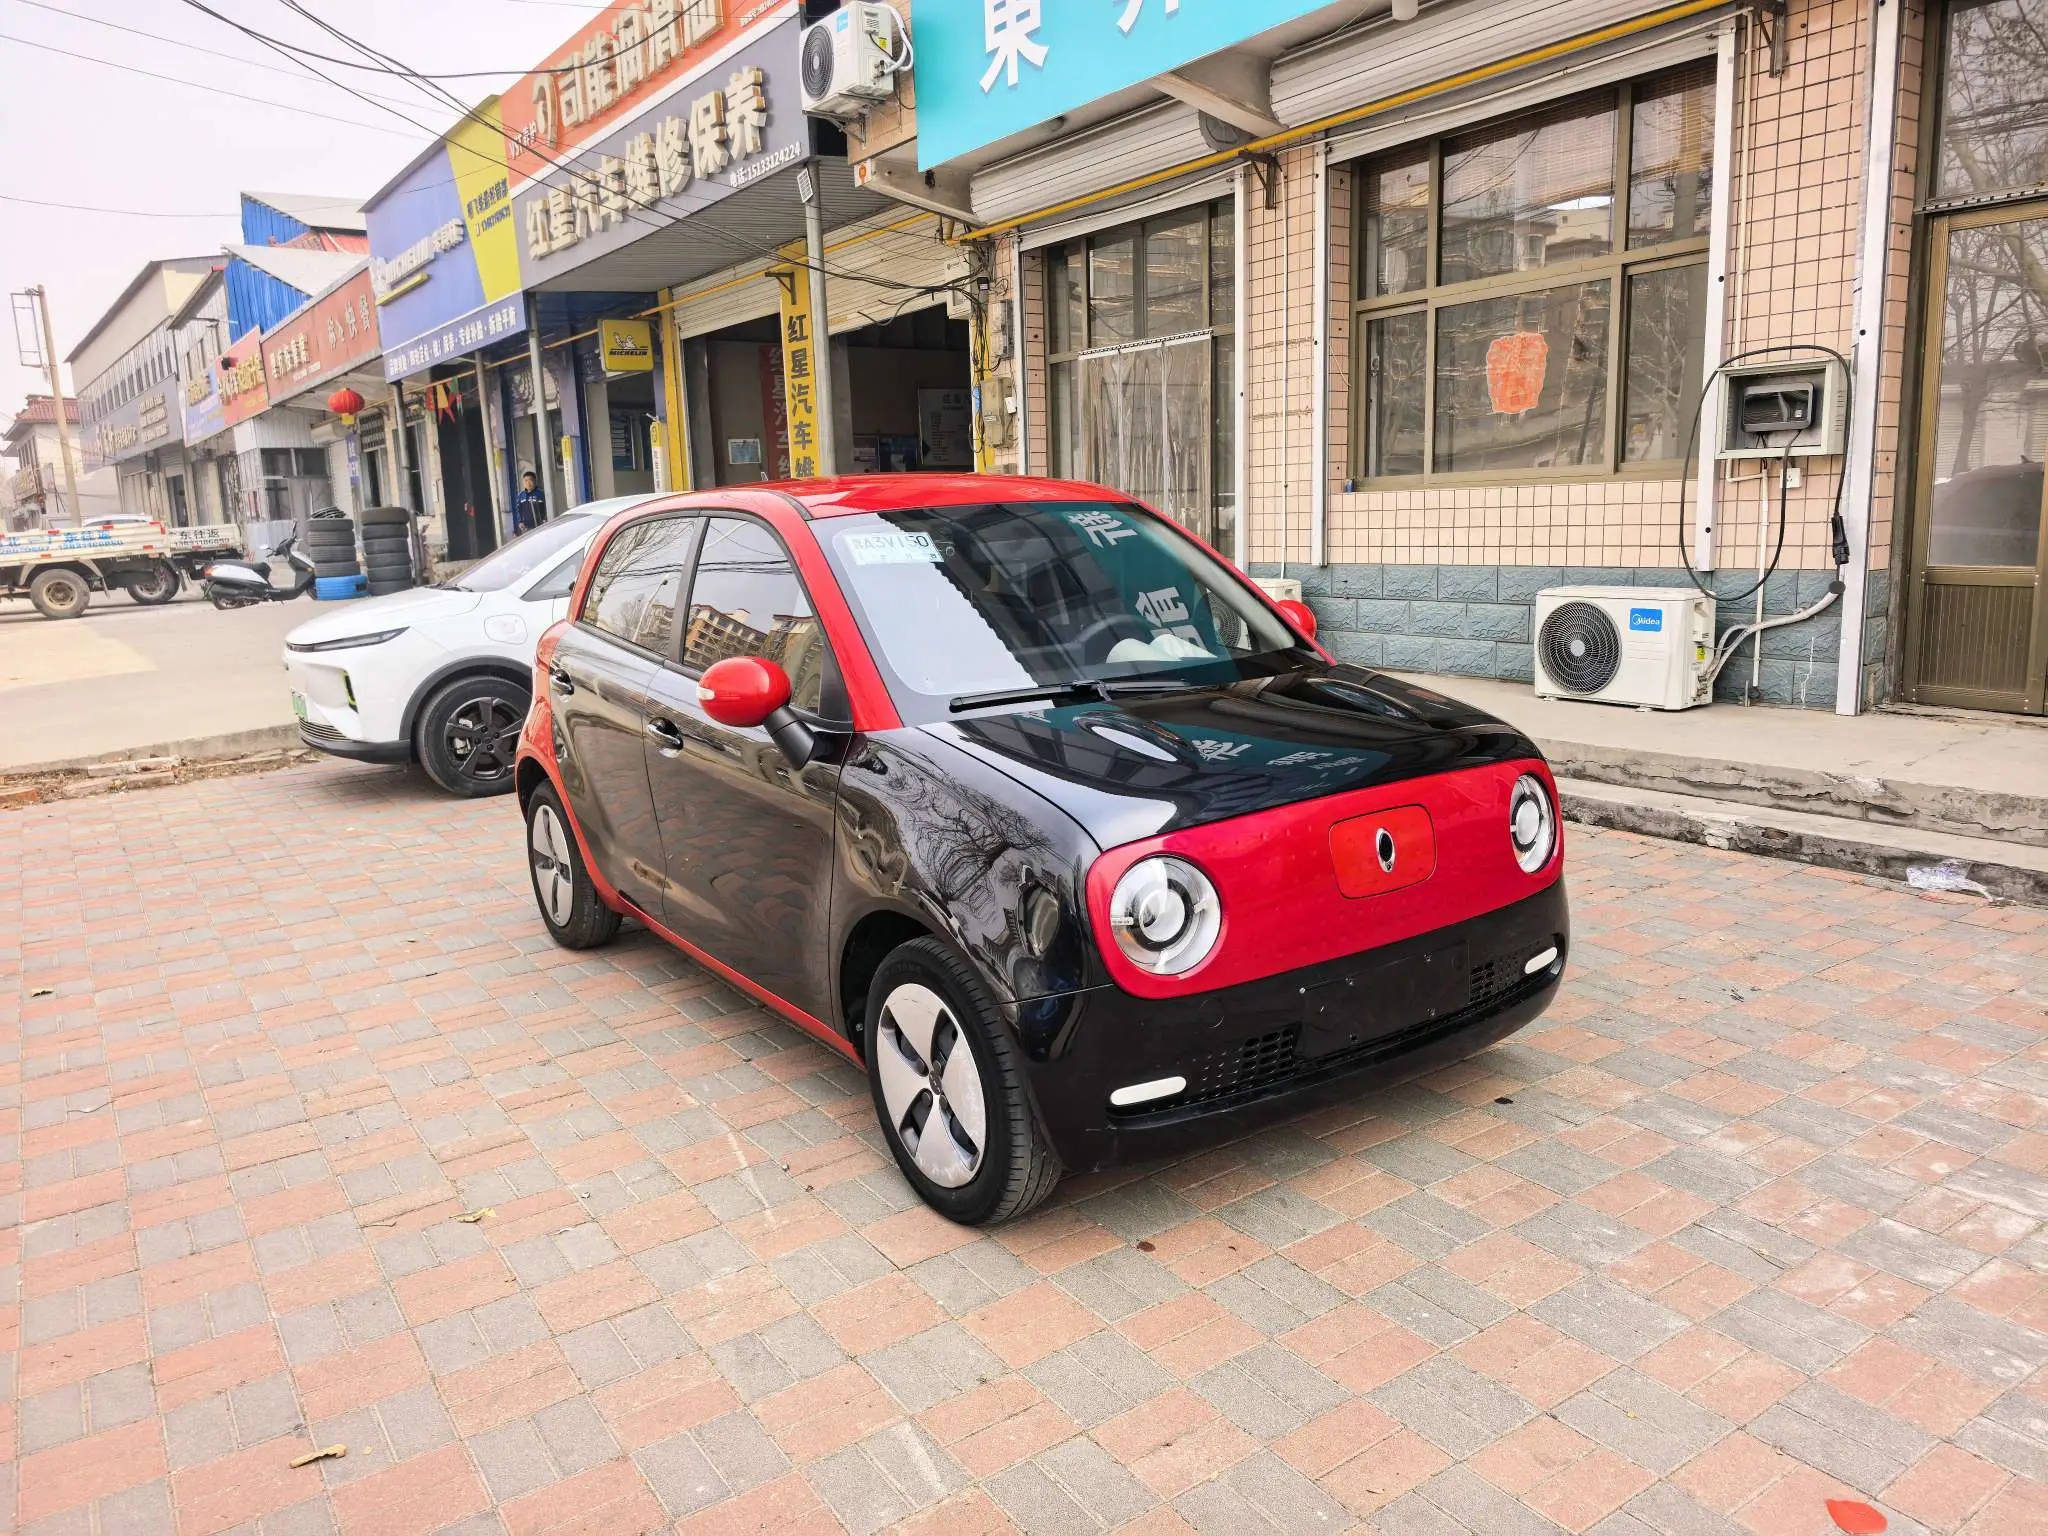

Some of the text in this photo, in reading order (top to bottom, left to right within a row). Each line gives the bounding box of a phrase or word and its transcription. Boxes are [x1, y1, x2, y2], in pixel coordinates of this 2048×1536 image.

[526, 66, 767, 260] 红星汽车维修保养
[787, 313, 817, 479] 红星汽车维
[180, 529, 220, 541] 东往返
[1632, 613, 1660, 625] Midea
